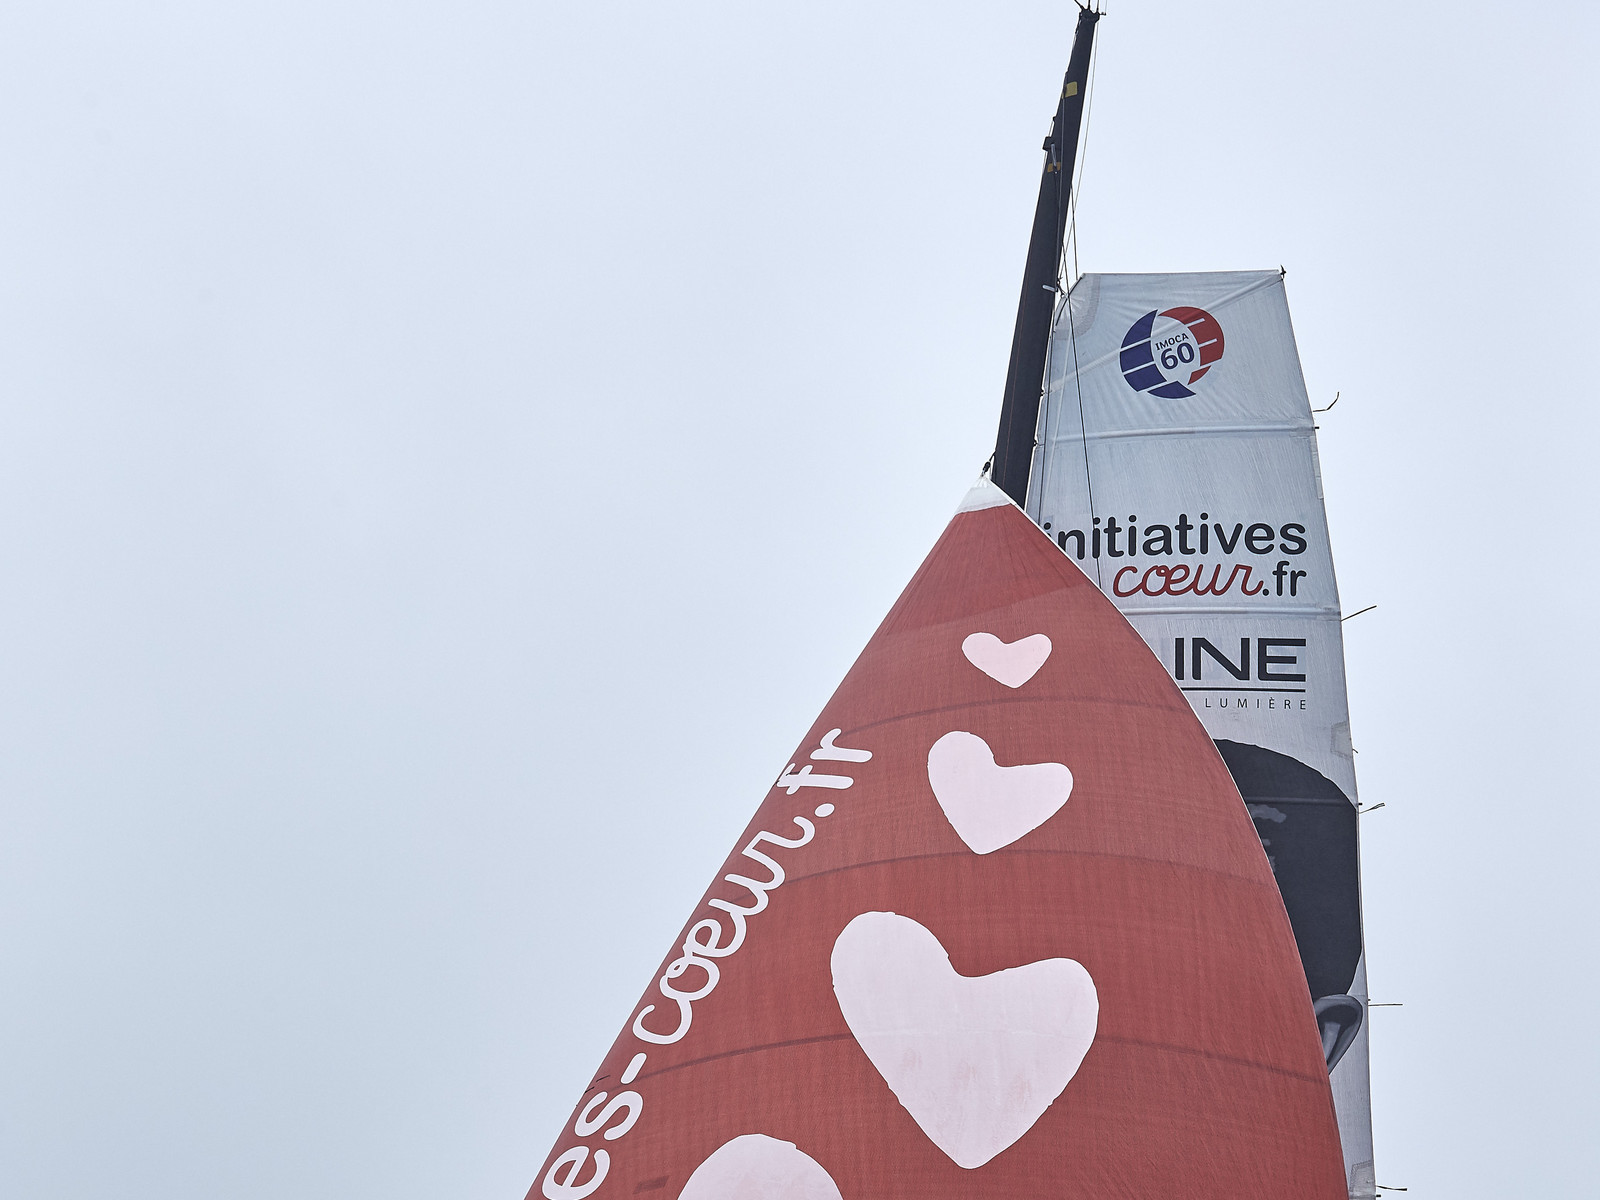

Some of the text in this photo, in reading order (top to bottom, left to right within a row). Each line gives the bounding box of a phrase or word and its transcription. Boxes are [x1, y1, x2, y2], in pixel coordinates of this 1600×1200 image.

[1155, 333, 1189, 350] IMOCA
[1161, 342, 1195, 370] 60
[1112, 560, 1307, 598] cœur.fr
[1204, 695, 1307, 711] LUMIÈRE
